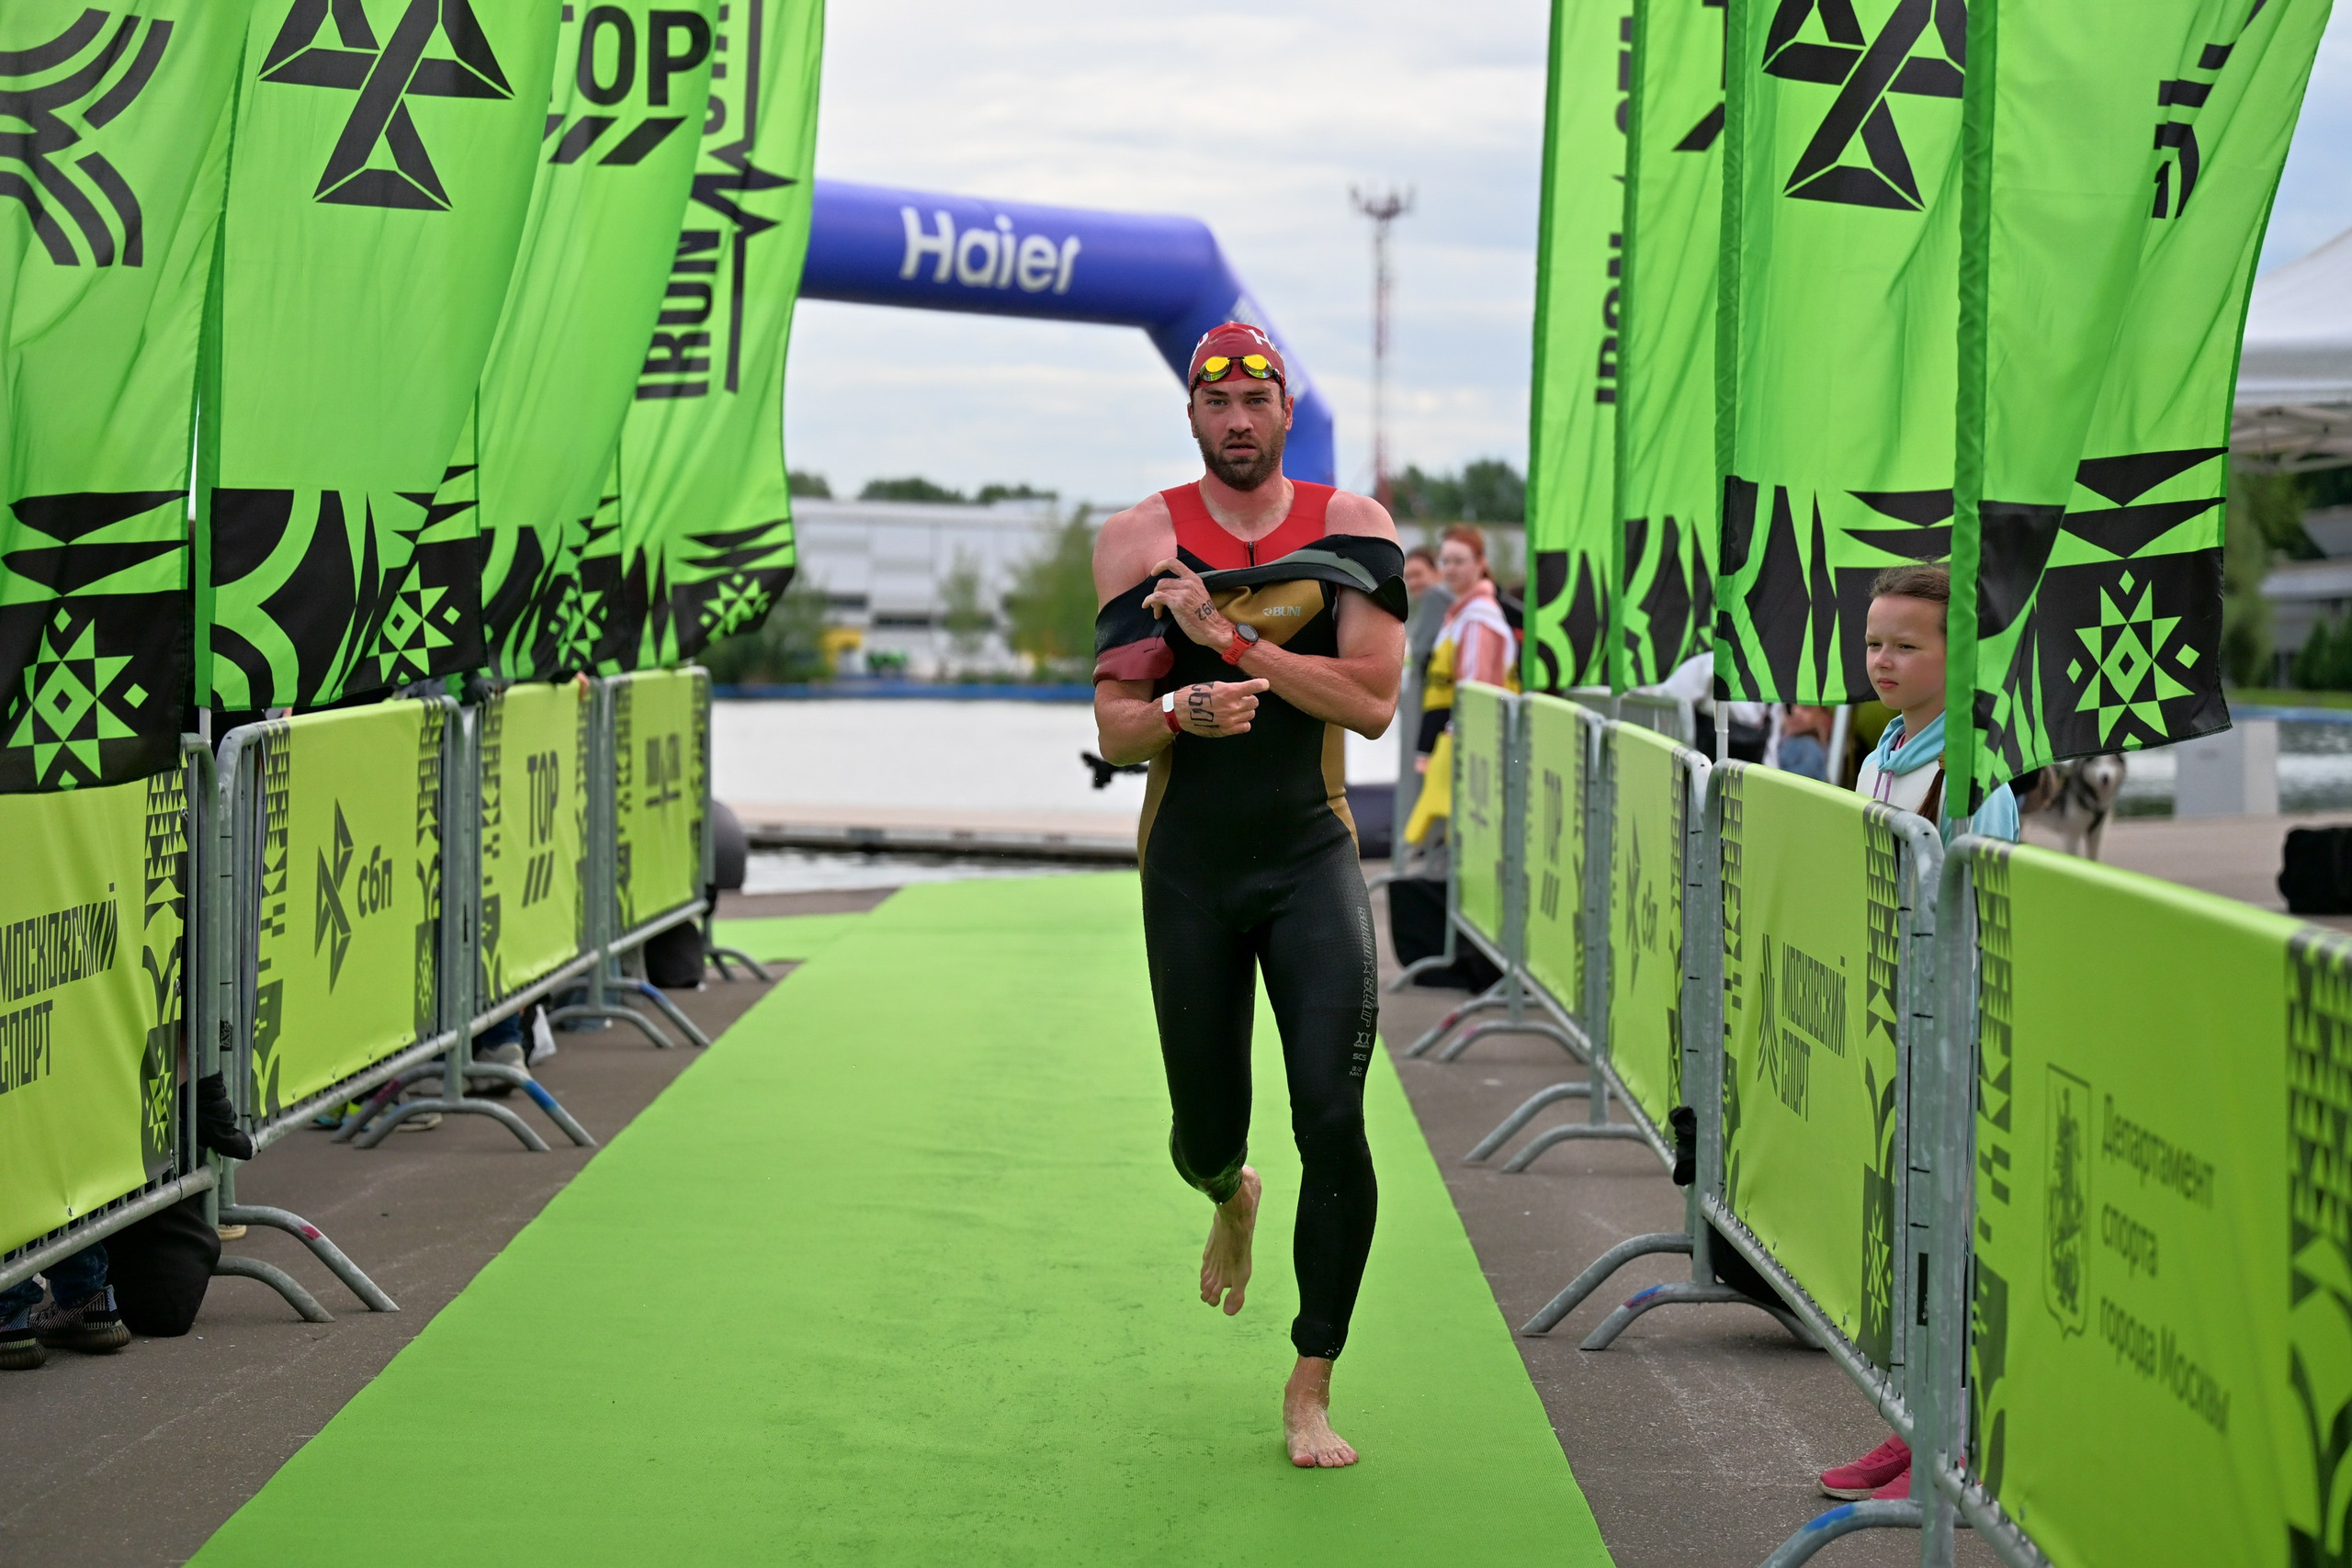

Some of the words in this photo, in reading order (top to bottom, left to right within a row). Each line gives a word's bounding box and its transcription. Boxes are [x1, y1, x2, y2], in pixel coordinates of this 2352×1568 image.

[561, 5, 712, 107] OP
[899, 204, 1081, 295] Haier
[527, 750, 559, 848] TOP
[0, 882, 118, 1003] МОСКОВСКИЙ
[0, 998, 53, 1095] СПОРТ
[1781, 942, 1846, 1058] МОСКОВСКИЙ
[1781, 1027, 1811, 1122] СПОРТ
[2101, 1093, 2214, 1210] Департамент
[2100, 1201, 2157, 1278] спорта
[2099, 1296, 2156, 1379] города
[2160, 1325, 2230, 1435] Москвы
